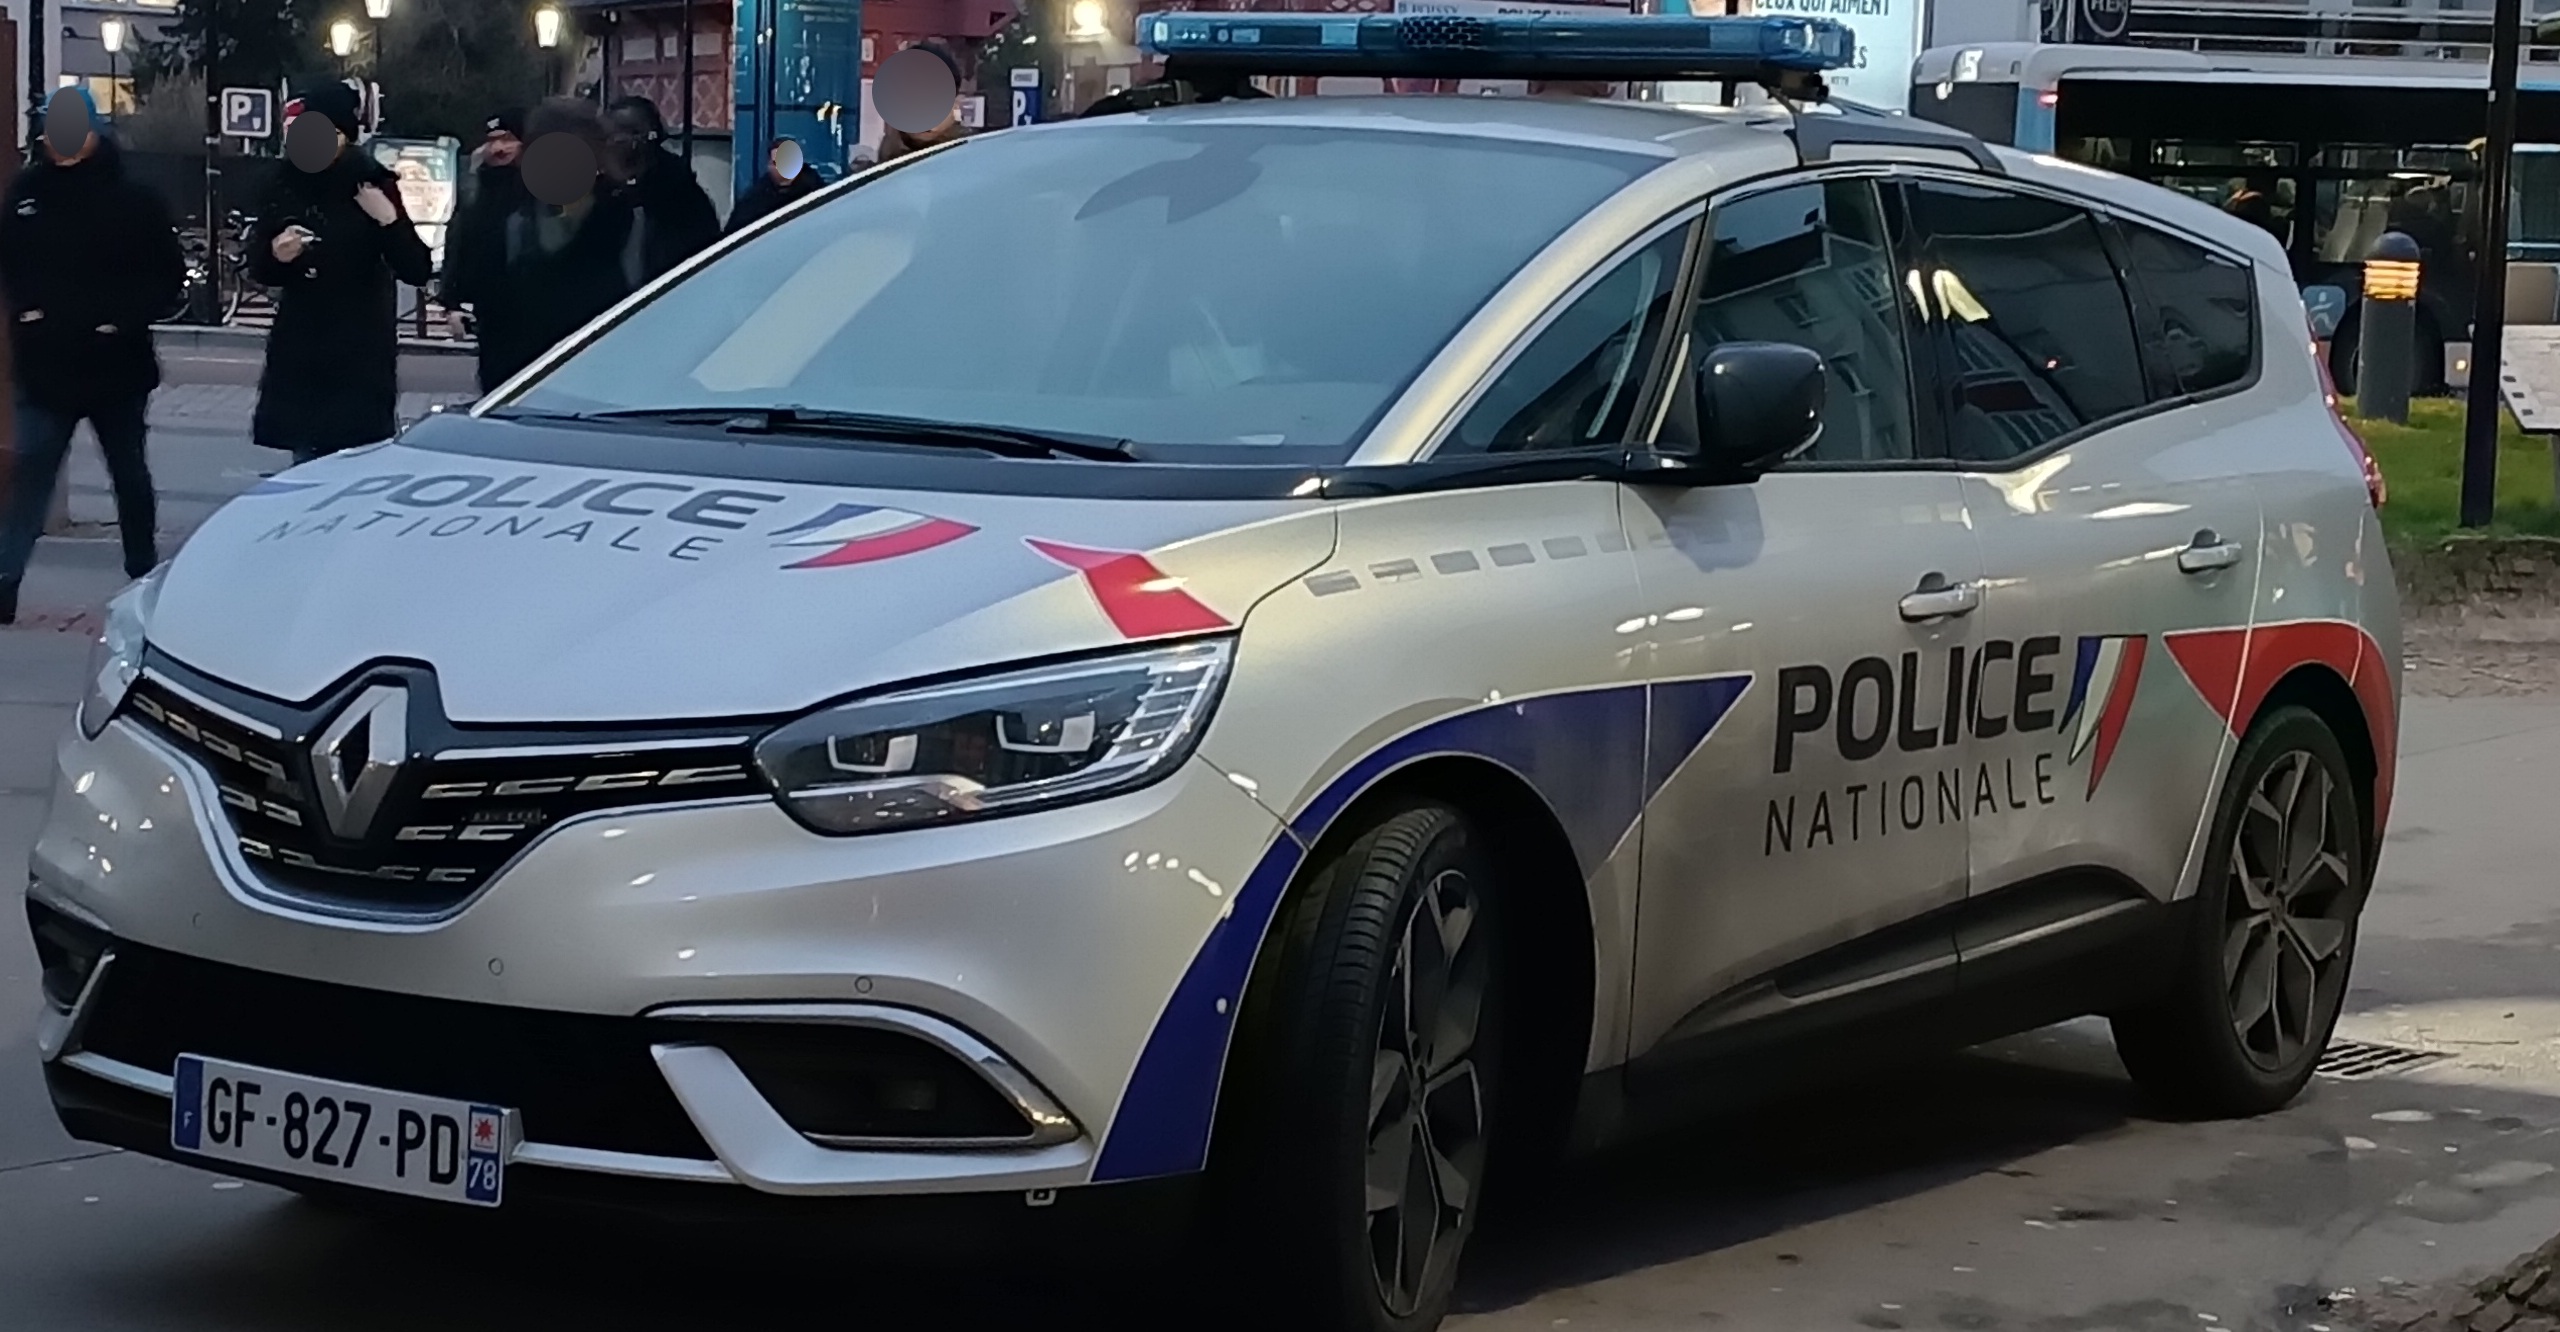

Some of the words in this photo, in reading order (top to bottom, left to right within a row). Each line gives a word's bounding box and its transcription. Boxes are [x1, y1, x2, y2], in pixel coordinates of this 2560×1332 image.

[230, 94, 252, 124] P
[307, 473, 786, 530] POLICE
[255, 510, 723, 562] NATIONALE
[1772, 635, 2061, 774] POLICE
[1764, 752, 2056, 857] NATIONALE
[206, 1076, 460, 1186] GF-827-PD
[469, 1157, 497, 1191] 78
